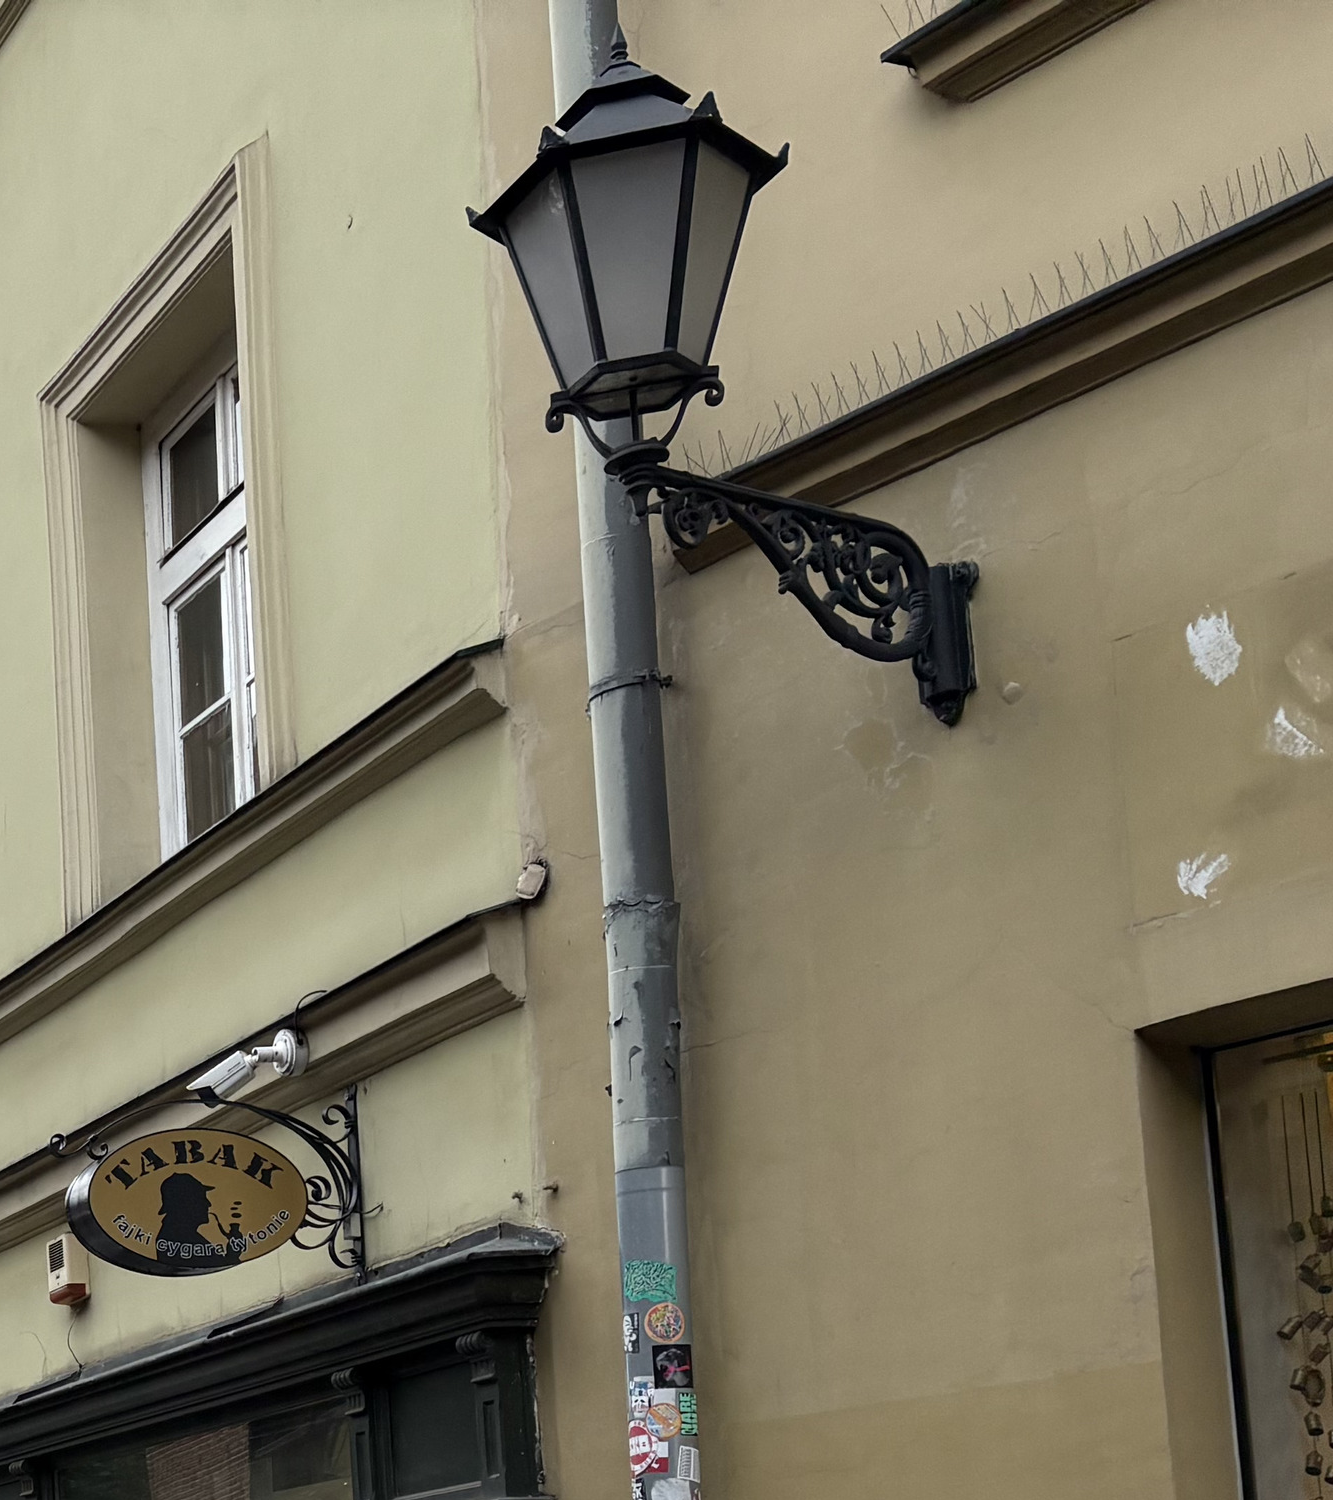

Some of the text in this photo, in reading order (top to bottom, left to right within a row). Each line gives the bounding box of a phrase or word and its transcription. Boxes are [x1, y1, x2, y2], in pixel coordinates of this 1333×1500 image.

[104, 1139, 284, 1190] TABAK
[112, 1208, 291, 1259] fajki cygara tytonie
